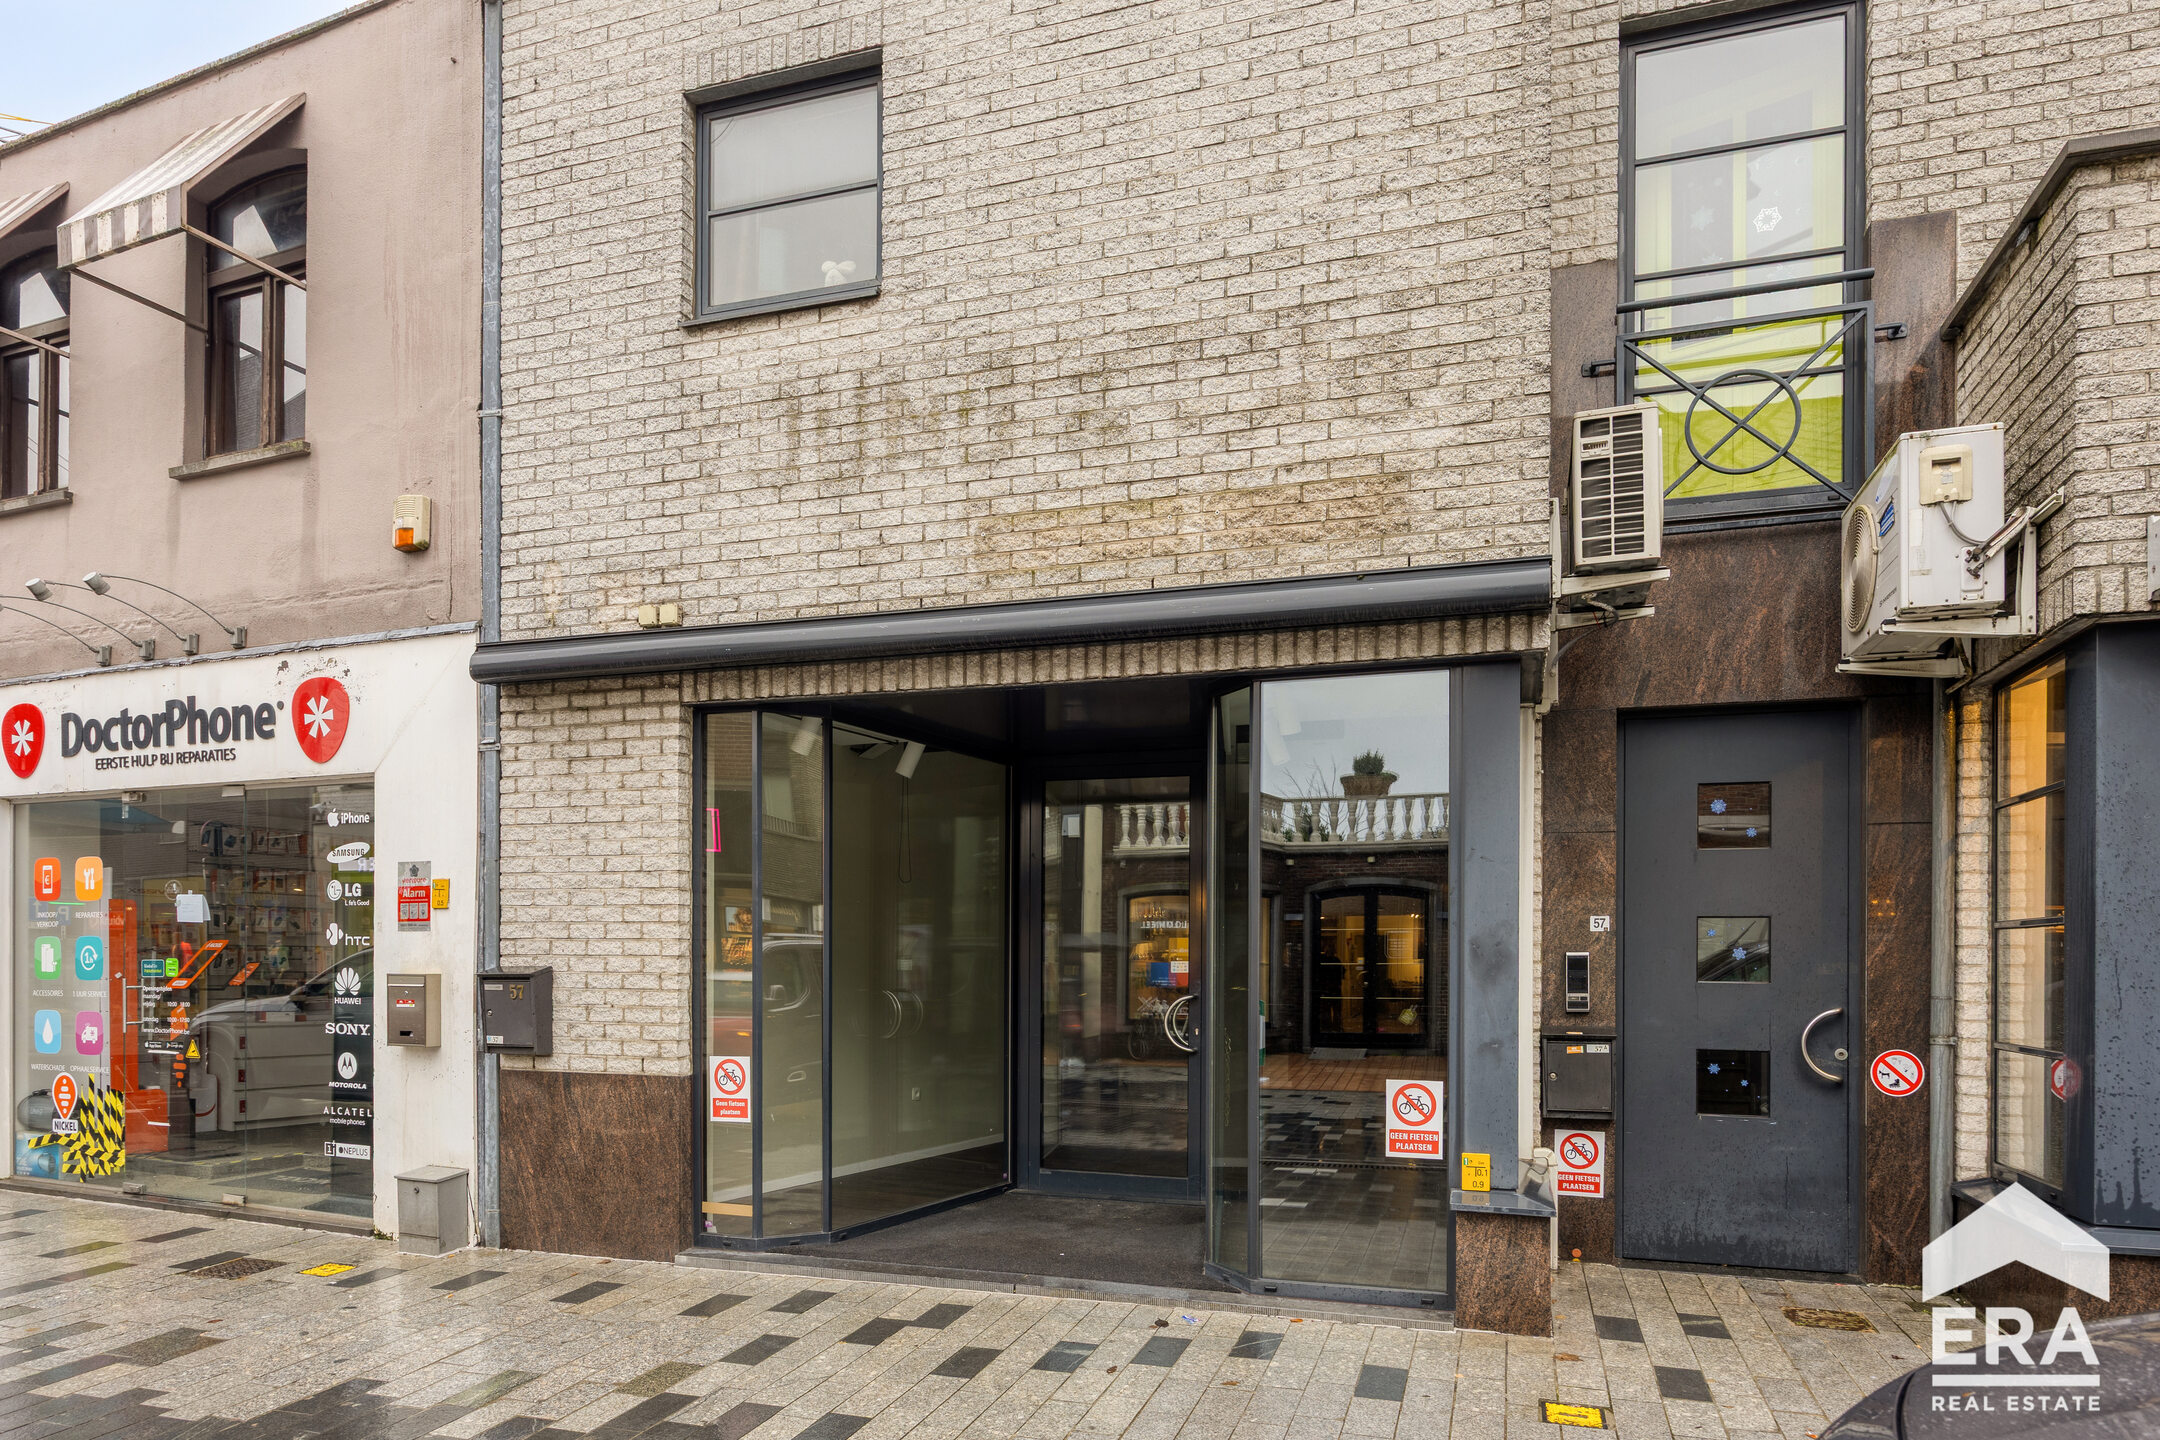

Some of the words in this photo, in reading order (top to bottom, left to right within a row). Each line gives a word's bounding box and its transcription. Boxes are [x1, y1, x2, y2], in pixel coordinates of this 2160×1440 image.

[61, 696, 276, 758] DoctorPhone
[95, 756, 129, 770] EERSTE
[131, 754, 158, 767] HULP
[160, 753, 174, 765] BIJ
[176, 748, 236, 763] REPARATIES
[340, 812, 370, 824] iPhone
[332, 848, 365, 857] SAMSUNG
[345, 883, 362, 897] LG
[402, 888, 426, 898] Alarm
[75, 911, 103, 919] REPARATIES
[1594, 917, 1606, 929] 57
[32, 989, 64, 997] ACCESSOIRES
[87, 990, 108, 998] SERVICE
[509, 984, 524, 1000] 57
[334, 997, 362, 1005] HUAWEI
[31, 1063, 66, 1072] WATERSCHADE
[69, 1065, 110, 1073] OPHAALSERVICE
[328, 1081, 367, 1090] MOTOROLA
[323, 1106, 373, 1118] ALCATEL
[54, 1120, 77, 1131] NICKEL
[329, 1117, 347, 1125] mobile
[347, 1118, 366, 1126] phones
[1390, 1132, 1408, 1140] GEEN
[1409, 1133, 1439, 1142] FIETSEN
[1395, 1142, 1432, 1151] PLAATSEN
[338, 1146, 369, 1157] ONEPLUS
[1575, 1175, 1600, 1183] FIETSEN
[1472, 1180, 1484, 1188] 0.9
[1562, 1182, 1595, 1191] PLAATSEN
